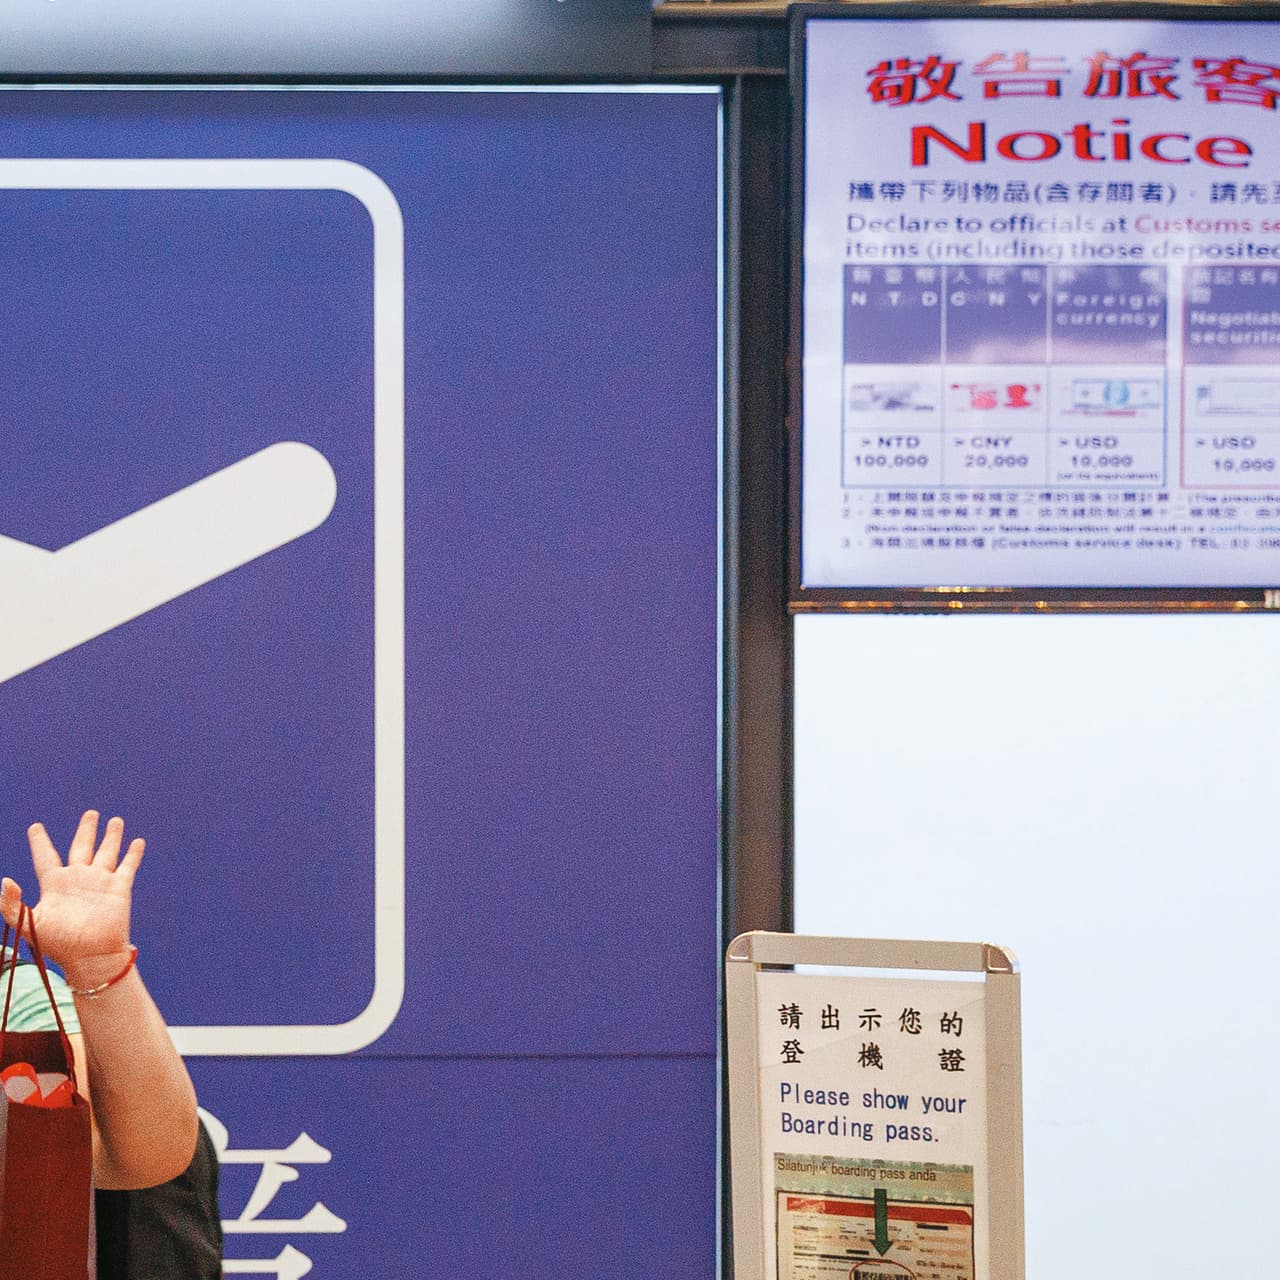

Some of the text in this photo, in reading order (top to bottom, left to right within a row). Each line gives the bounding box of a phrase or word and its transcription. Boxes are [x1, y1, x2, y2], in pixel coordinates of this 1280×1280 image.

[910, 118, 1254, 168] Notice
[847, 213, 948, 234] Declare
[956, 215, 982, 234] to
[990, 213, 1095, 234] officials
[1102, 216, 1127, 234] at
[1135, 213, 1251, 234] Customs
[846, 240, 919, 259] items
[927, 239, 1063, 262] (including
[1070, 240, 1145, 259] those
[777, 1002, 963, 1037] 請出示您的
[780, 1038, 966, 1072] 登機證
[780, 1082, 967, 1114] Please show your
[781, 1112, 939, 1143] Boarding pass.
[831, 1162, 876, 1180] boarding
[880, 1168, 906, 1181] pass
[909, 1168, 937, 1182] anda
